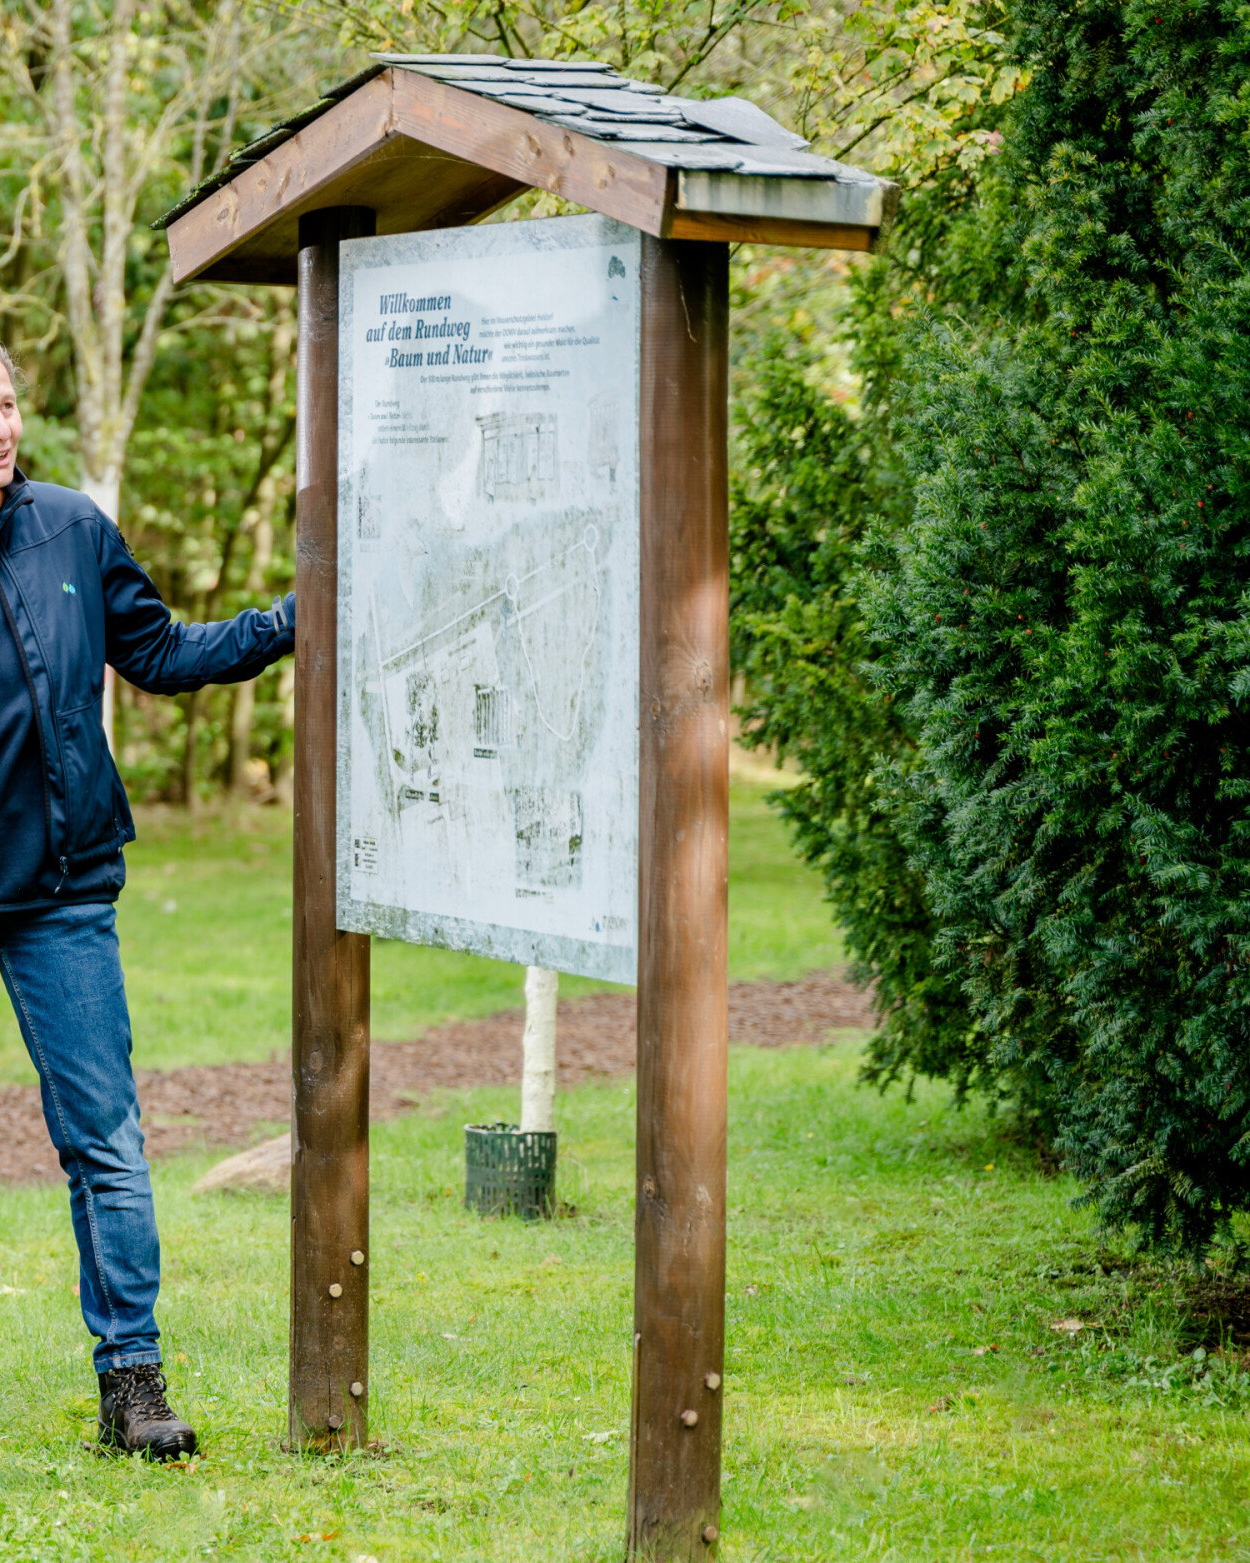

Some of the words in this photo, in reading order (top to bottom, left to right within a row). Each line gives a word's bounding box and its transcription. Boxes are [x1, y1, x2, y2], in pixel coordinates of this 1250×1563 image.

[379, 293, 451, 314] Willkommen
[366, 321, 387, 342] auf
[388, 320, 411, 341] dem
[415, 318, 470, 341] Rundweg
[427, 344, 450, 367] und
